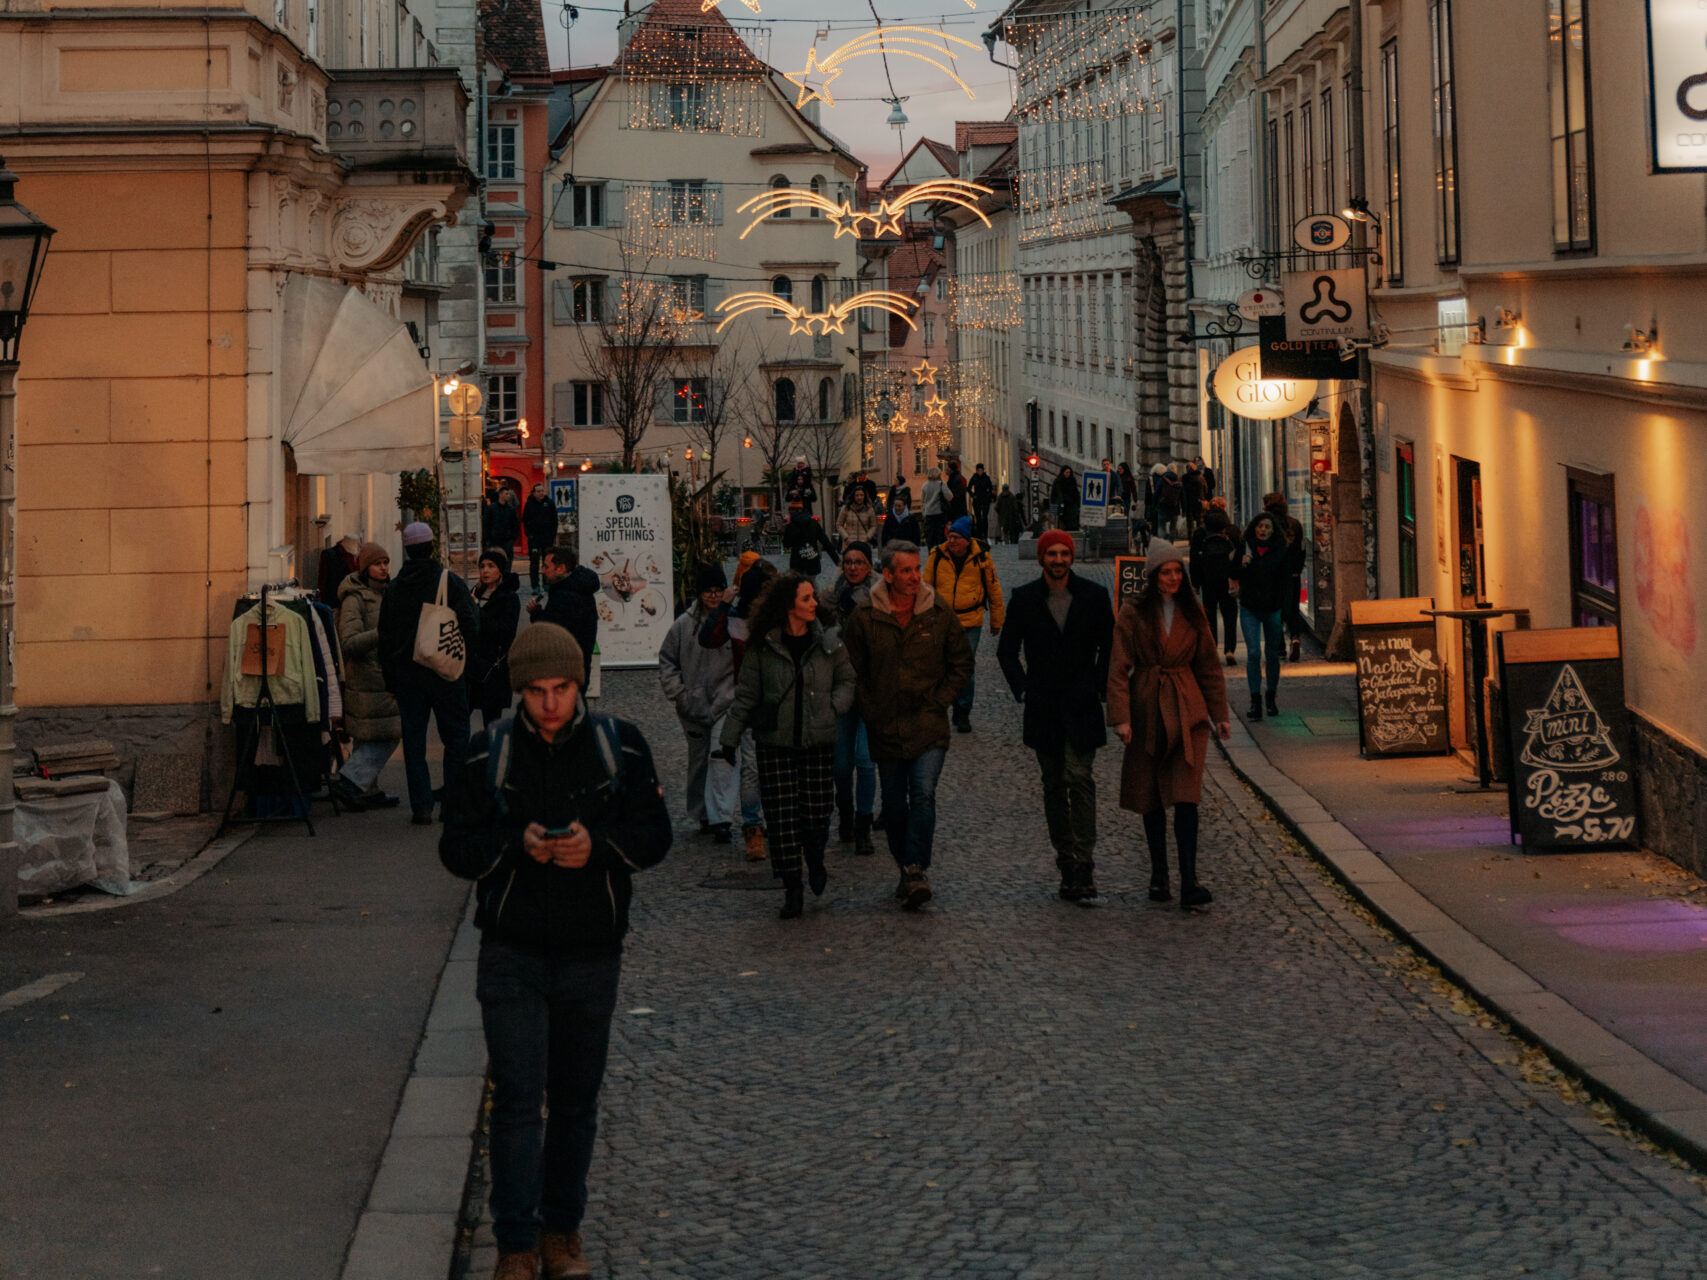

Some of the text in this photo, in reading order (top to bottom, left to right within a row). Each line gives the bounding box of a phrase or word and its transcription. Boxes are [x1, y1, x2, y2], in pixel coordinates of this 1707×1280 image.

[1270, 341, 1304, 351] GOLD
[1236, 382, 1297, 403] GLOU
[605, 516, 646, 529] SPECIAL
[596, 529, 655, 542] HOT THINGS
[1546, 712, 1590, 738] mini
[1525, 769, 1617, 823] Pizza
